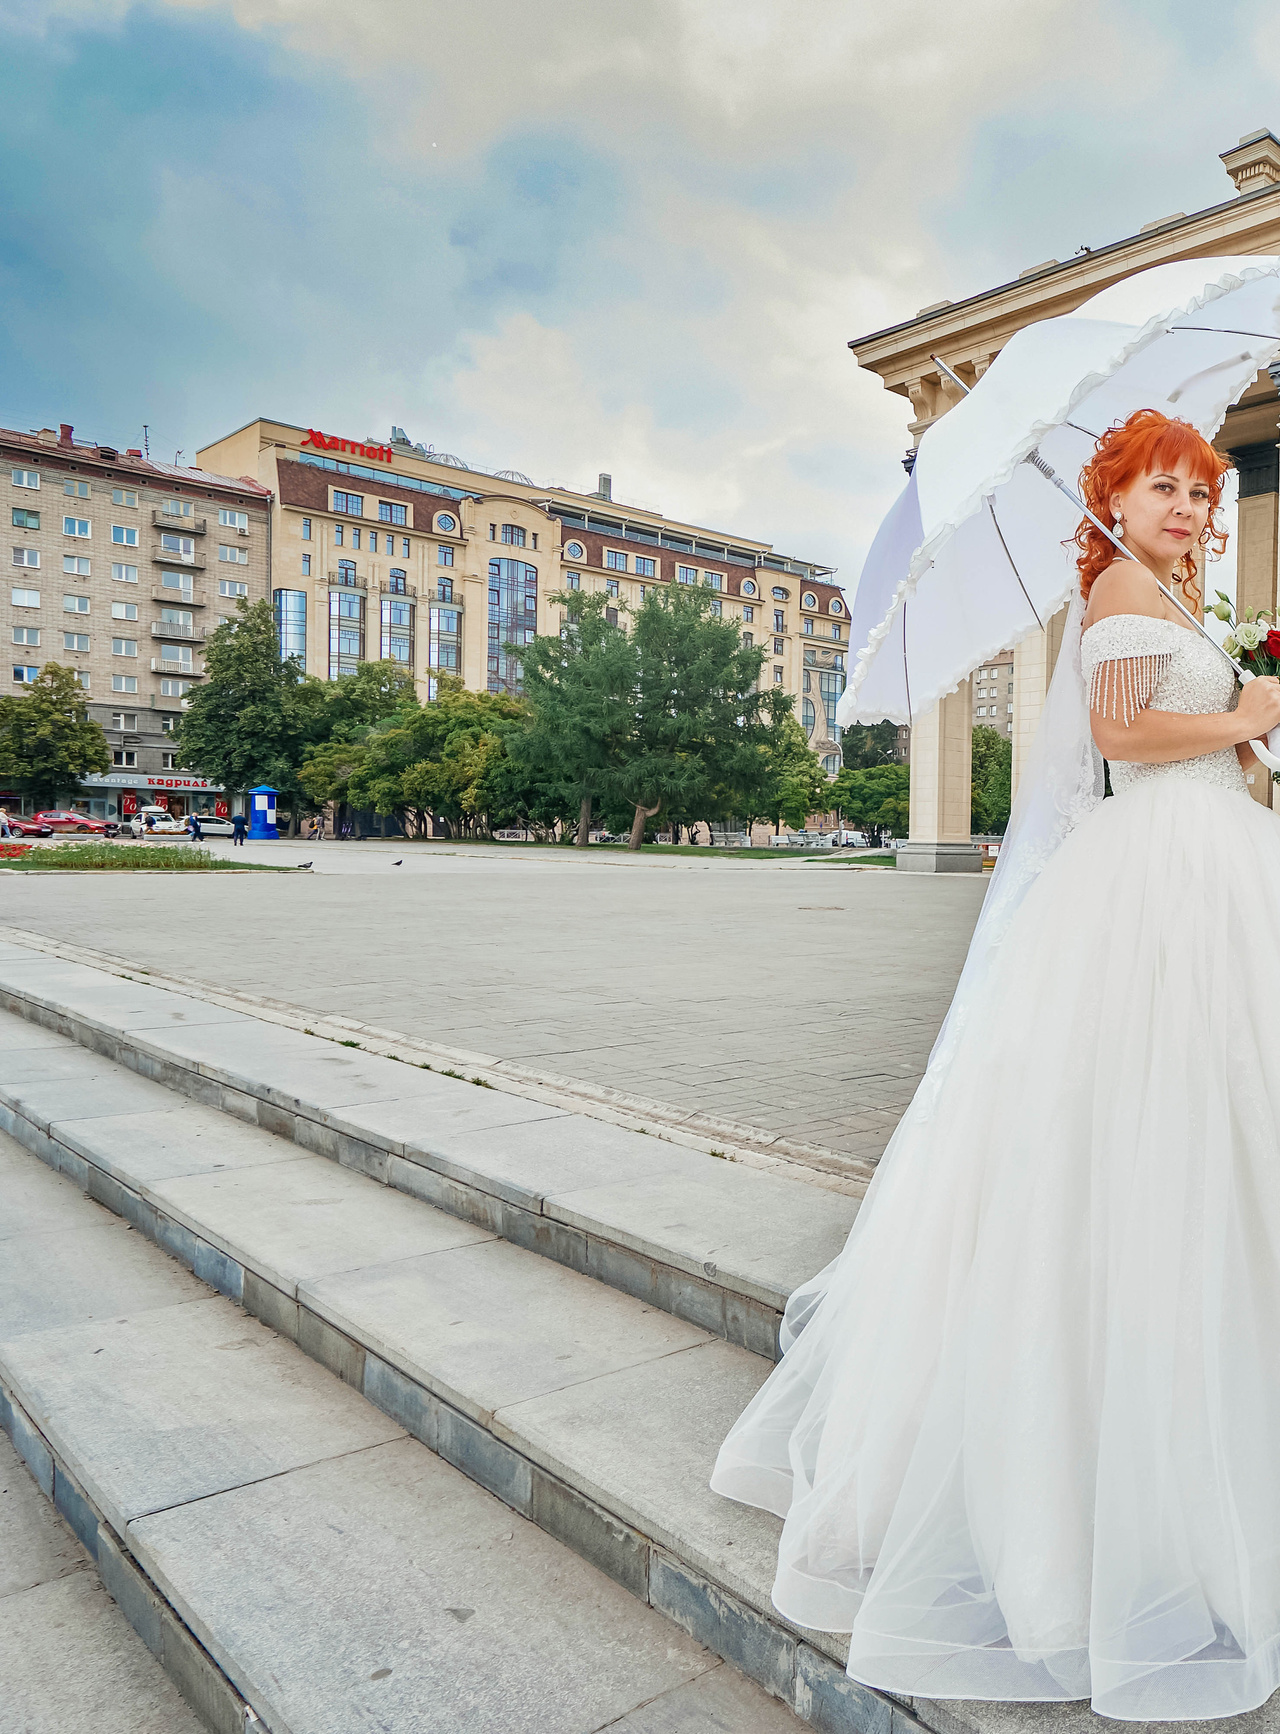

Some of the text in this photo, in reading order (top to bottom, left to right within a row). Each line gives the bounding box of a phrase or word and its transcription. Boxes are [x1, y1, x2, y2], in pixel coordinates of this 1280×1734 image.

[301, 428, 393, 463] Marriott
[92, 776, 139, 784] avantage
[147, 778, 208, 788] кадриль
